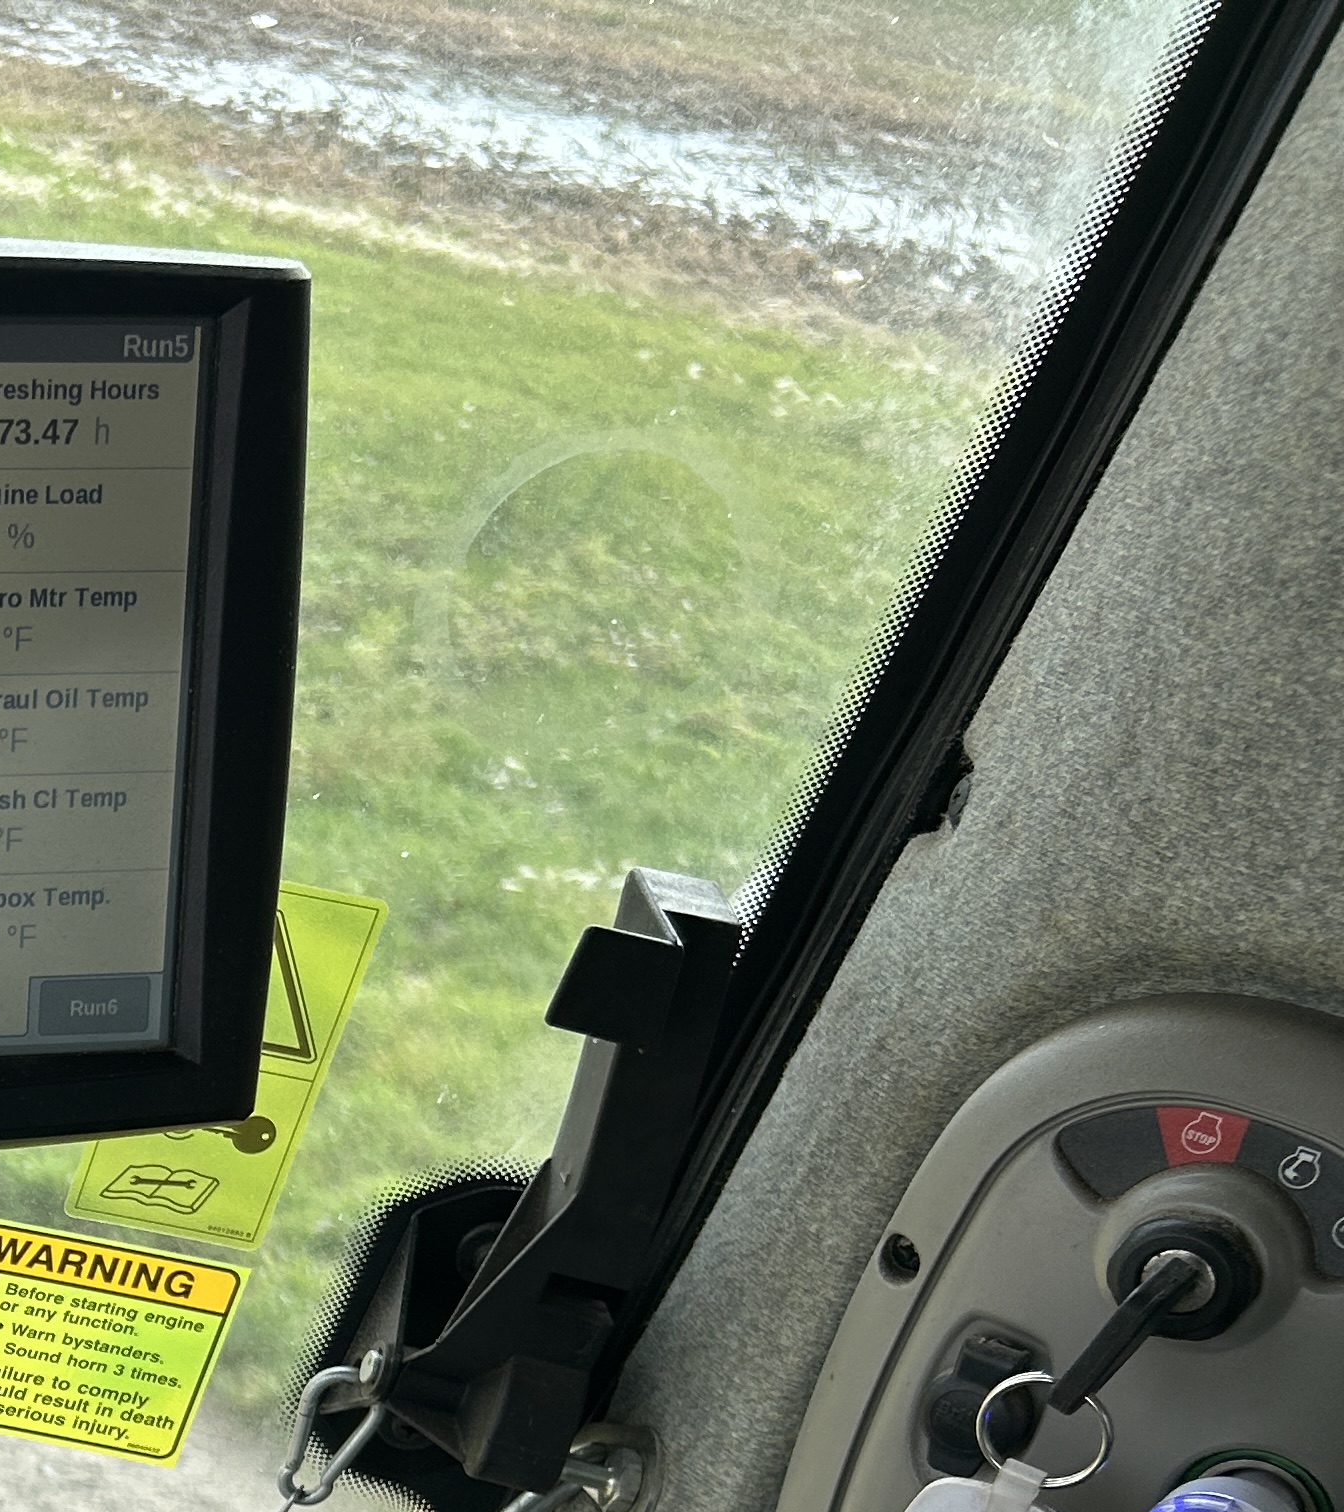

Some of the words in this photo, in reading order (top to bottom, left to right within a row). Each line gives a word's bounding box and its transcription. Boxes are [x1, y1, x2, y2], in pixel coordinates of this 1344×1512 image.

[123, 334, 189, 358] Run5
[90, 379, 160, 400] Hours
[94, 416, 109, 445] h
[45, 484, 102, 505] Load
[29, 588, 67, 608] Mtr
[75, 587, 137, 612] Temp
[45, 688, 78, 708] Oil
[86, 688, 148, 713] Temp
[65, 789, 127, 812] Temp
[43, 887, 110, 911] Temp.
[69, 998, 118, 1017] Run6
[1186, 1129, 1217, 1146] STOP
[0, 1300, 19, 1312] or
[24, 1306, 57, 1323] any
[63, 1311, 139, 1337] function.
[5, 1283, 65, 1305] Before
[70, 1292, 139, 1322] starting
[144, 1312, 205, 1333] engine
[11, 1322, 56, 1343] Warn
[62, 1332, 164, 1365] bystanders.
[3, 1342, 62, 1364] Sound
[67, 1354, 108, 1373] horn
[112, 1363, 126, 1377] 3
[130, 1366, 182, 1389] times.
[52, 1376, 70, 1391] to
[77, 1383, 149, 1409] comply
[33, 1391, 90, 1413] result
[95, 1402, 113, 1418] in
[120, 1408, 175, 1430] death
[72, 1415, 130, 1441] injury.
